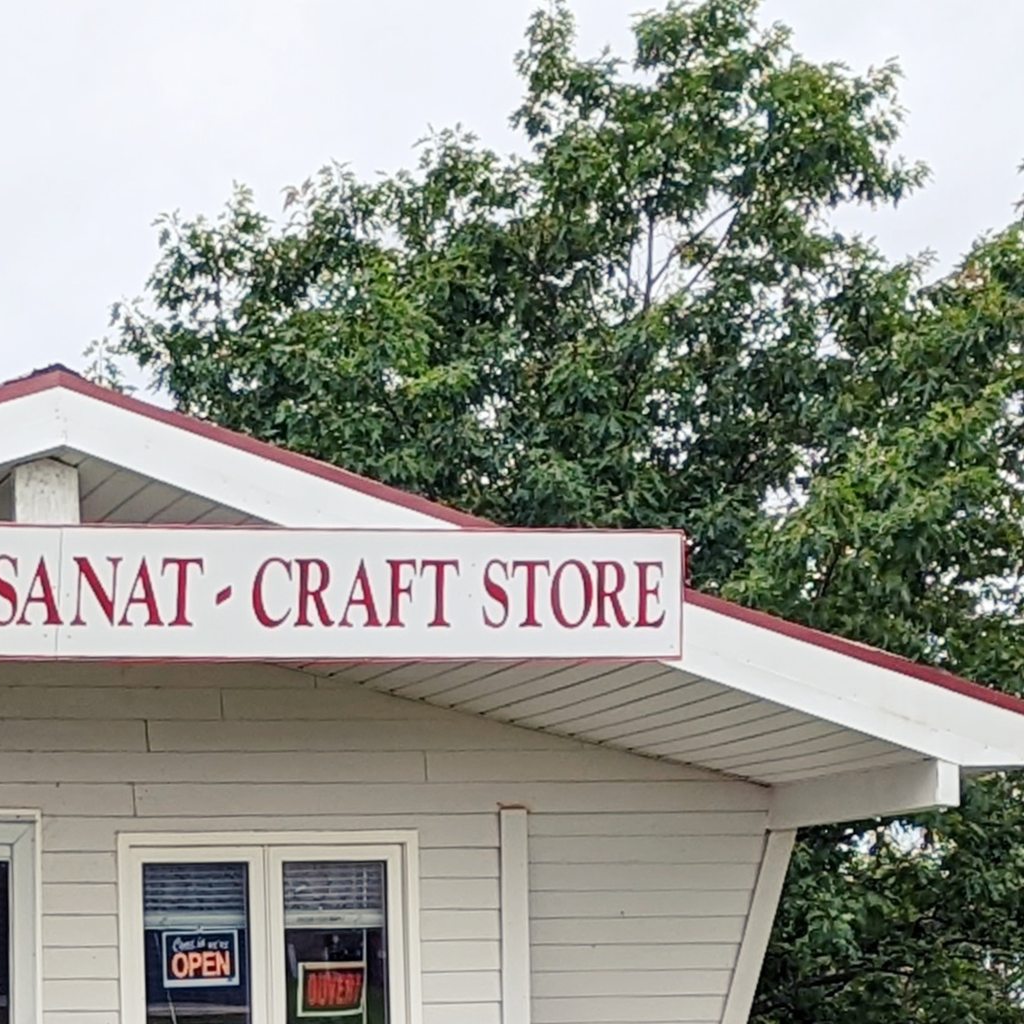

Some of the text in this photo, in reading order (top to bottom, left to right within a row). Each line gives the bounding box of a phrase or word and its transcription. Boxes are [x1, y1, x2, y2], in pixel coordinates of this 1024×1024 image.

[251, 556, 460, 628] CRAFT
[481, 558, 667, 629] STORE
[171, 950, 231, 979] OPEN
[307, 971, 362, 1006] OUVERT
